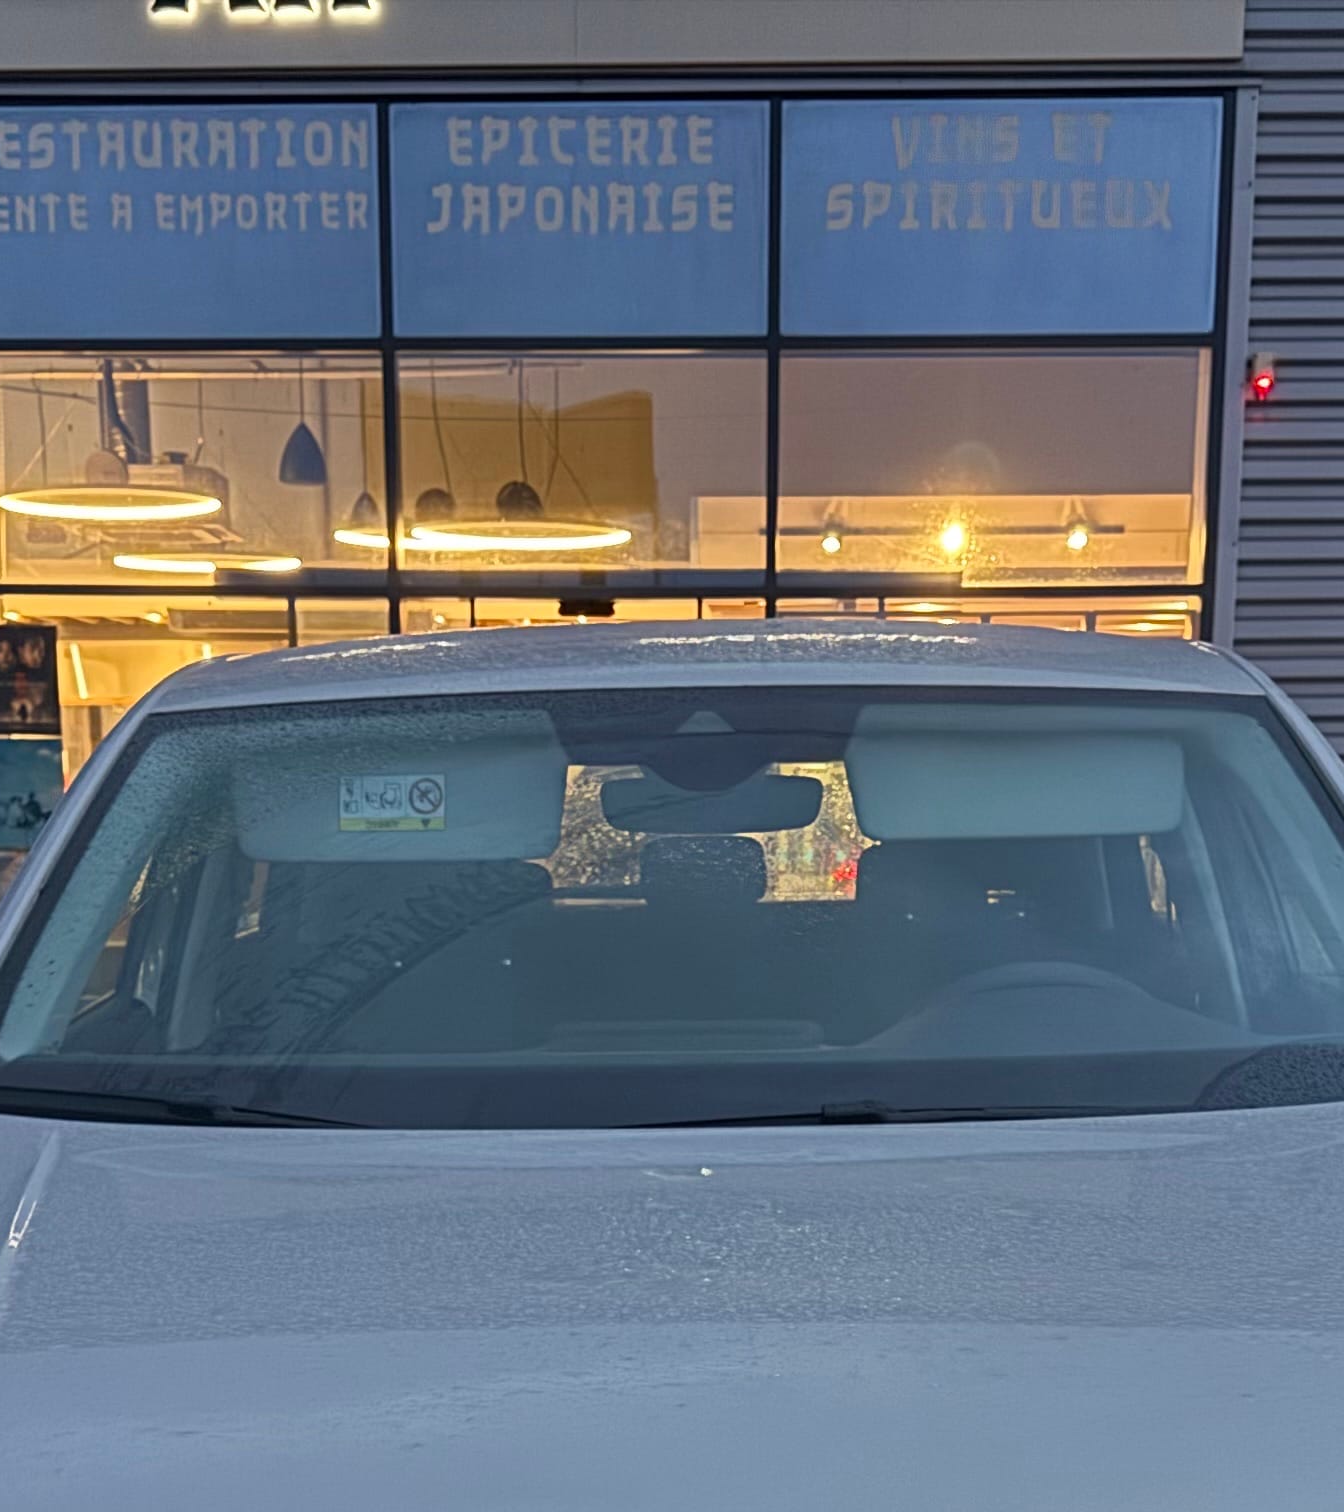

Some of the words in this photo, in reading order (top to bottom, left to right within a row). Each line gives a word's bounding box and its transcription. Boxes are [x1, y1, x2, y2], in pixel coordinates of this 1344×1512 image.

[446, 115, 714, 167] EPICERIE
[891, 113, 1021, 171] VINS
[1051, 111, 1113, 164] ET
[111, 193, 133, 232] A
[155, 191, 368, 237] EMPORTER
[426, 181, 735, 235] JAPONAISE
[825, 179, 1173, 231] SPIRITUEUX
